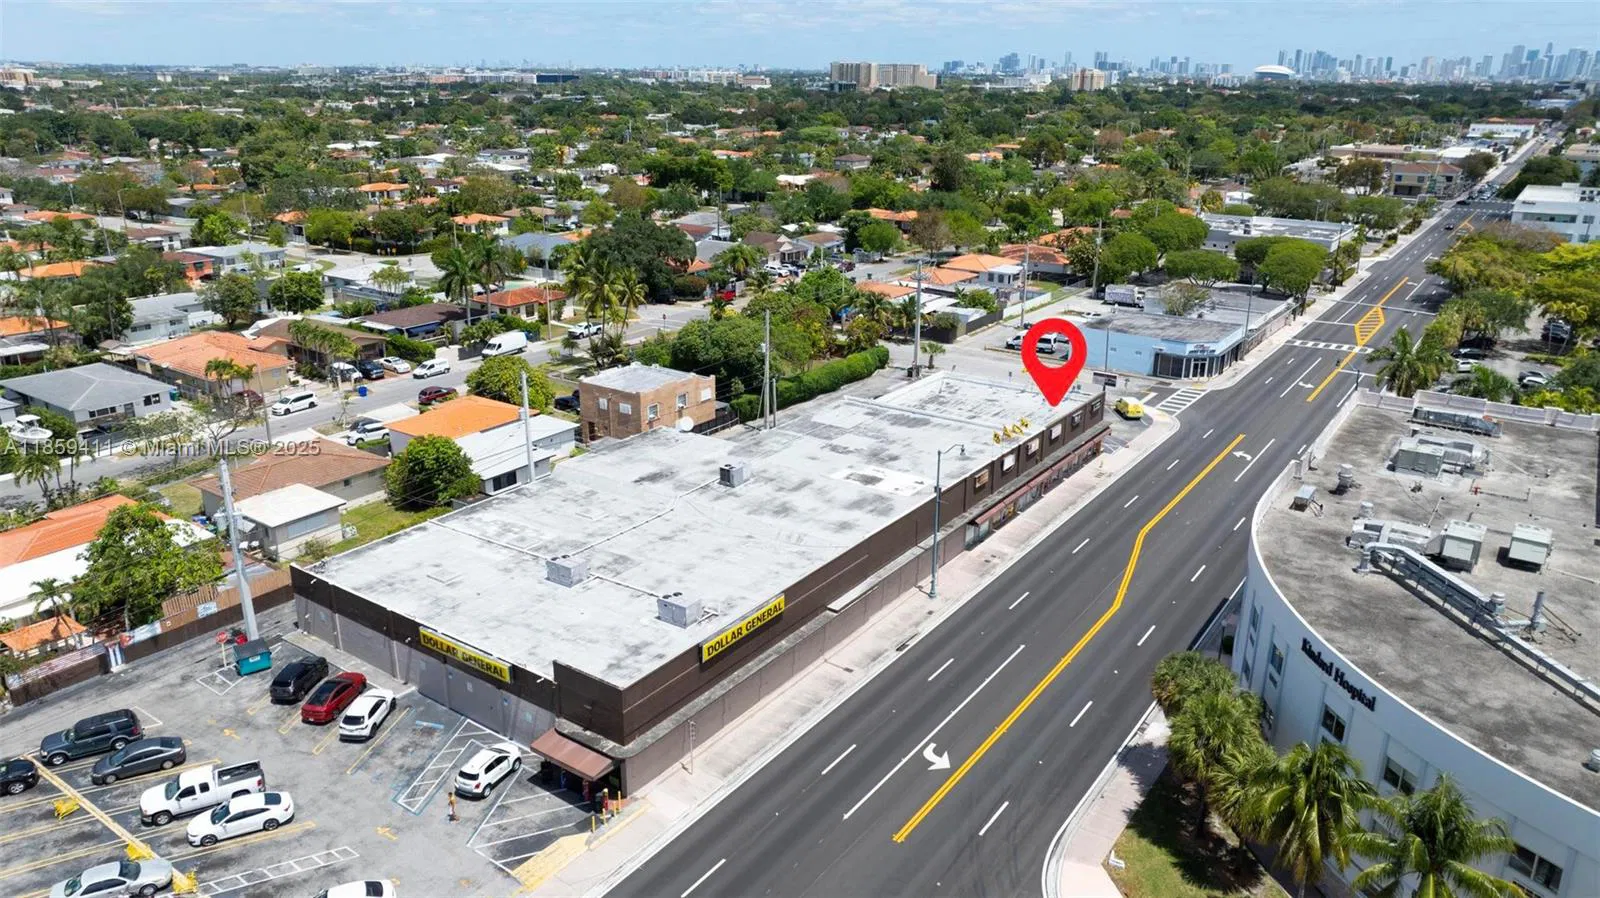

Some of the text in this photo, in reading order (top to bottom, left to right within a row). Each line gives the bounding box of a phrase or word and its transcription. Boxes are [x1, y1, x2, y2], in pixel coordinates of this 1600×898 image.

[707, 602, 783, 656] DOLLAR GENERAL
[422, 634, 505, 679] DOLLAR GENERAL
[1333, 667, 1376, 712] Hospital
